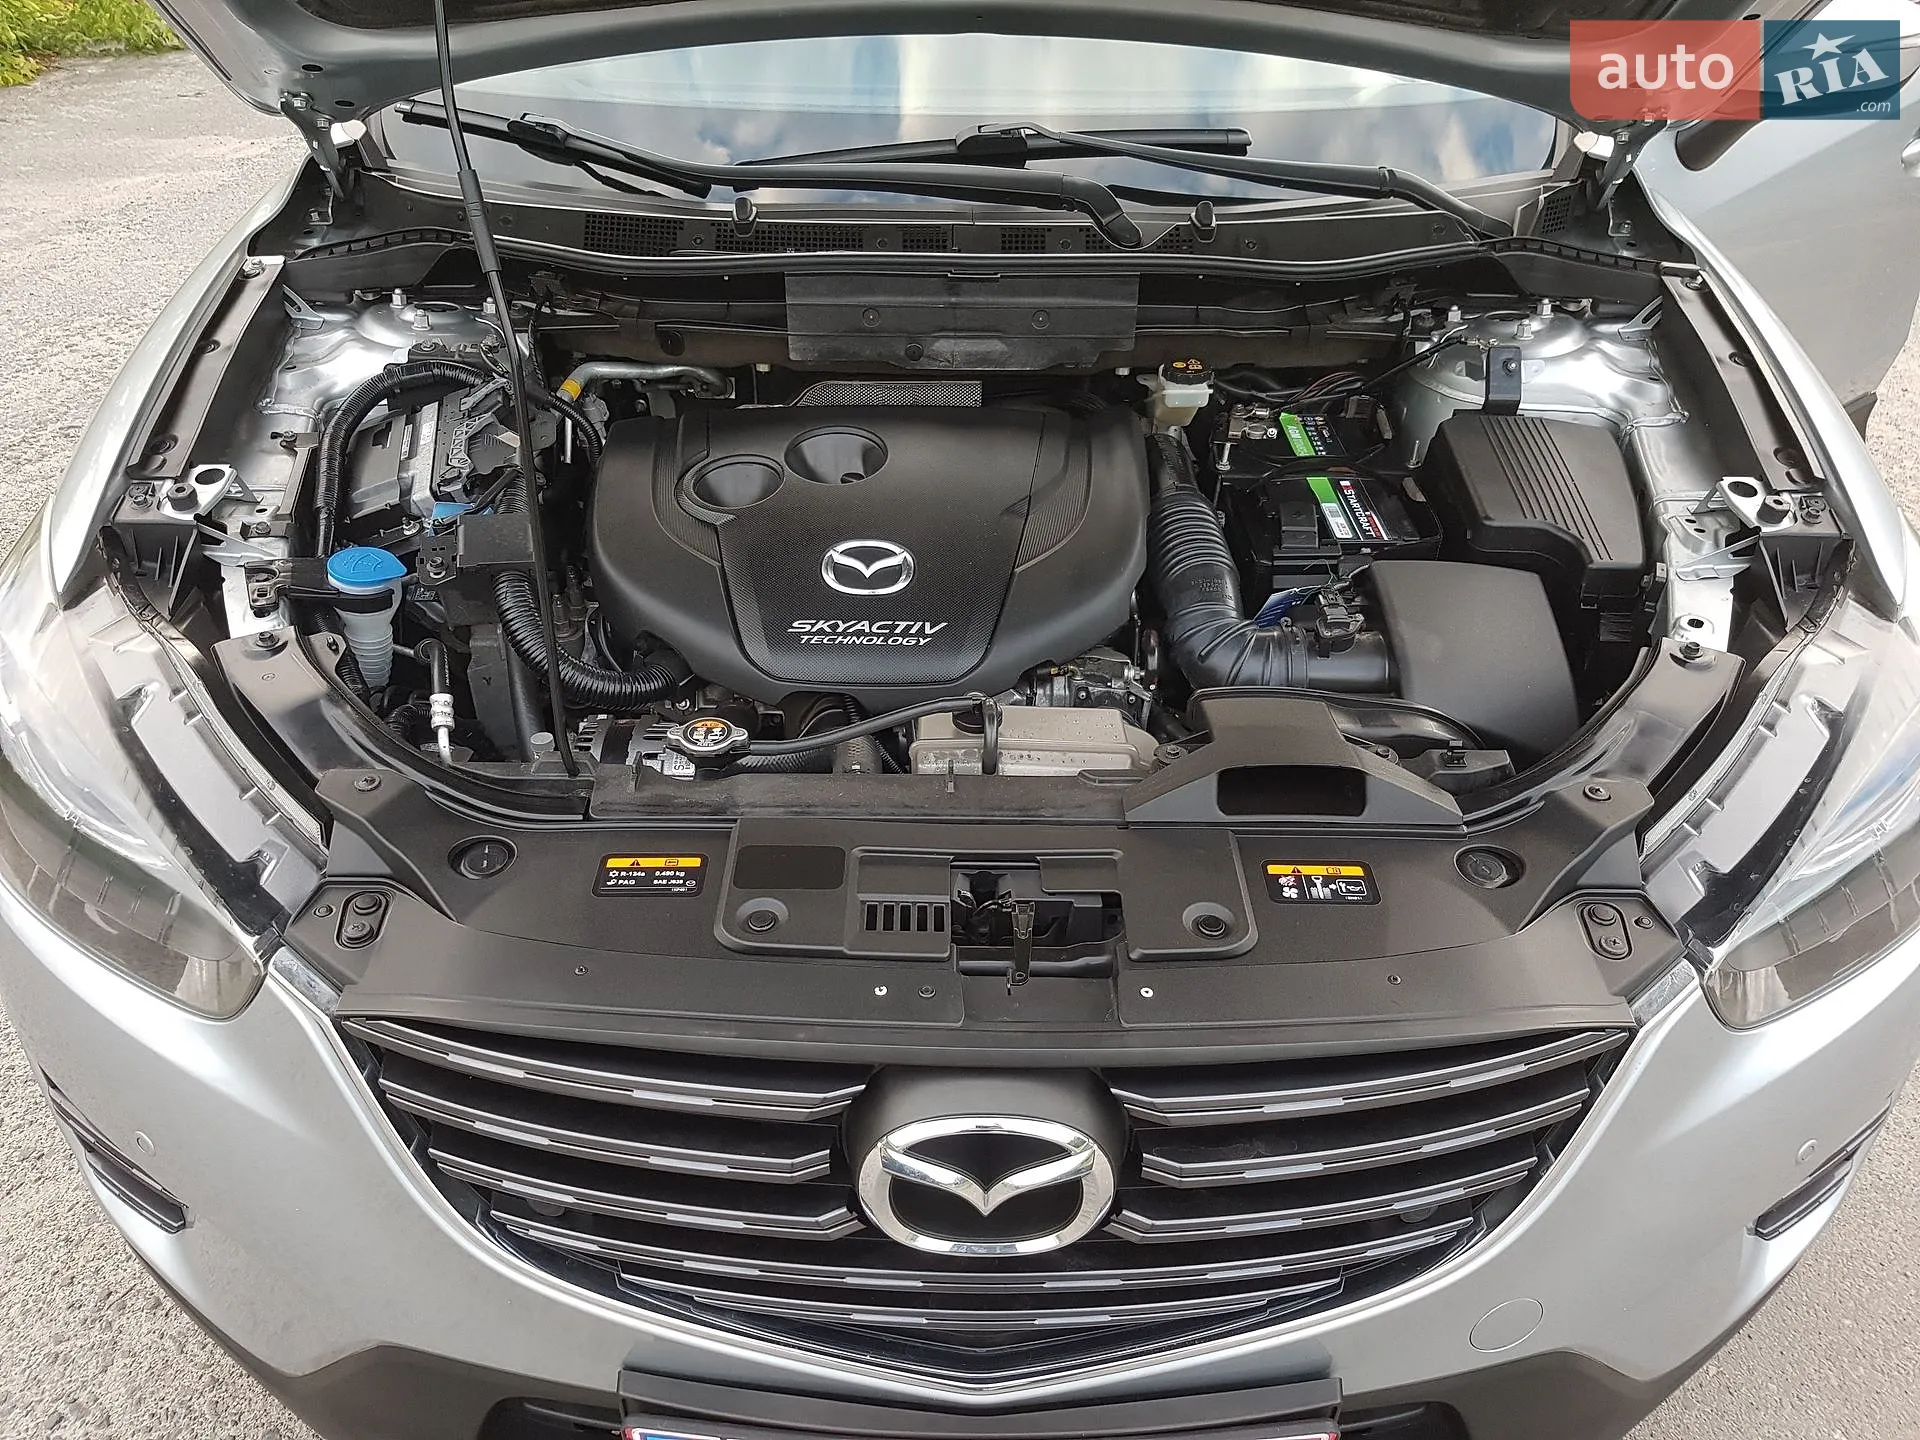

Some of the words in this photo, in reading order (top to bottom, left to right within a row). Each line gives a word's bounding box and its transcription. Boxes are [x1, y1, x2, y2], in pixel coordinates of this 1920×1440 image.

[1343, 489, 1377, 538] STARTCRAFT
[787, 619, 949, 634] SKYACTIV
[800, 635, 933, 646] TECHNOLOGY
